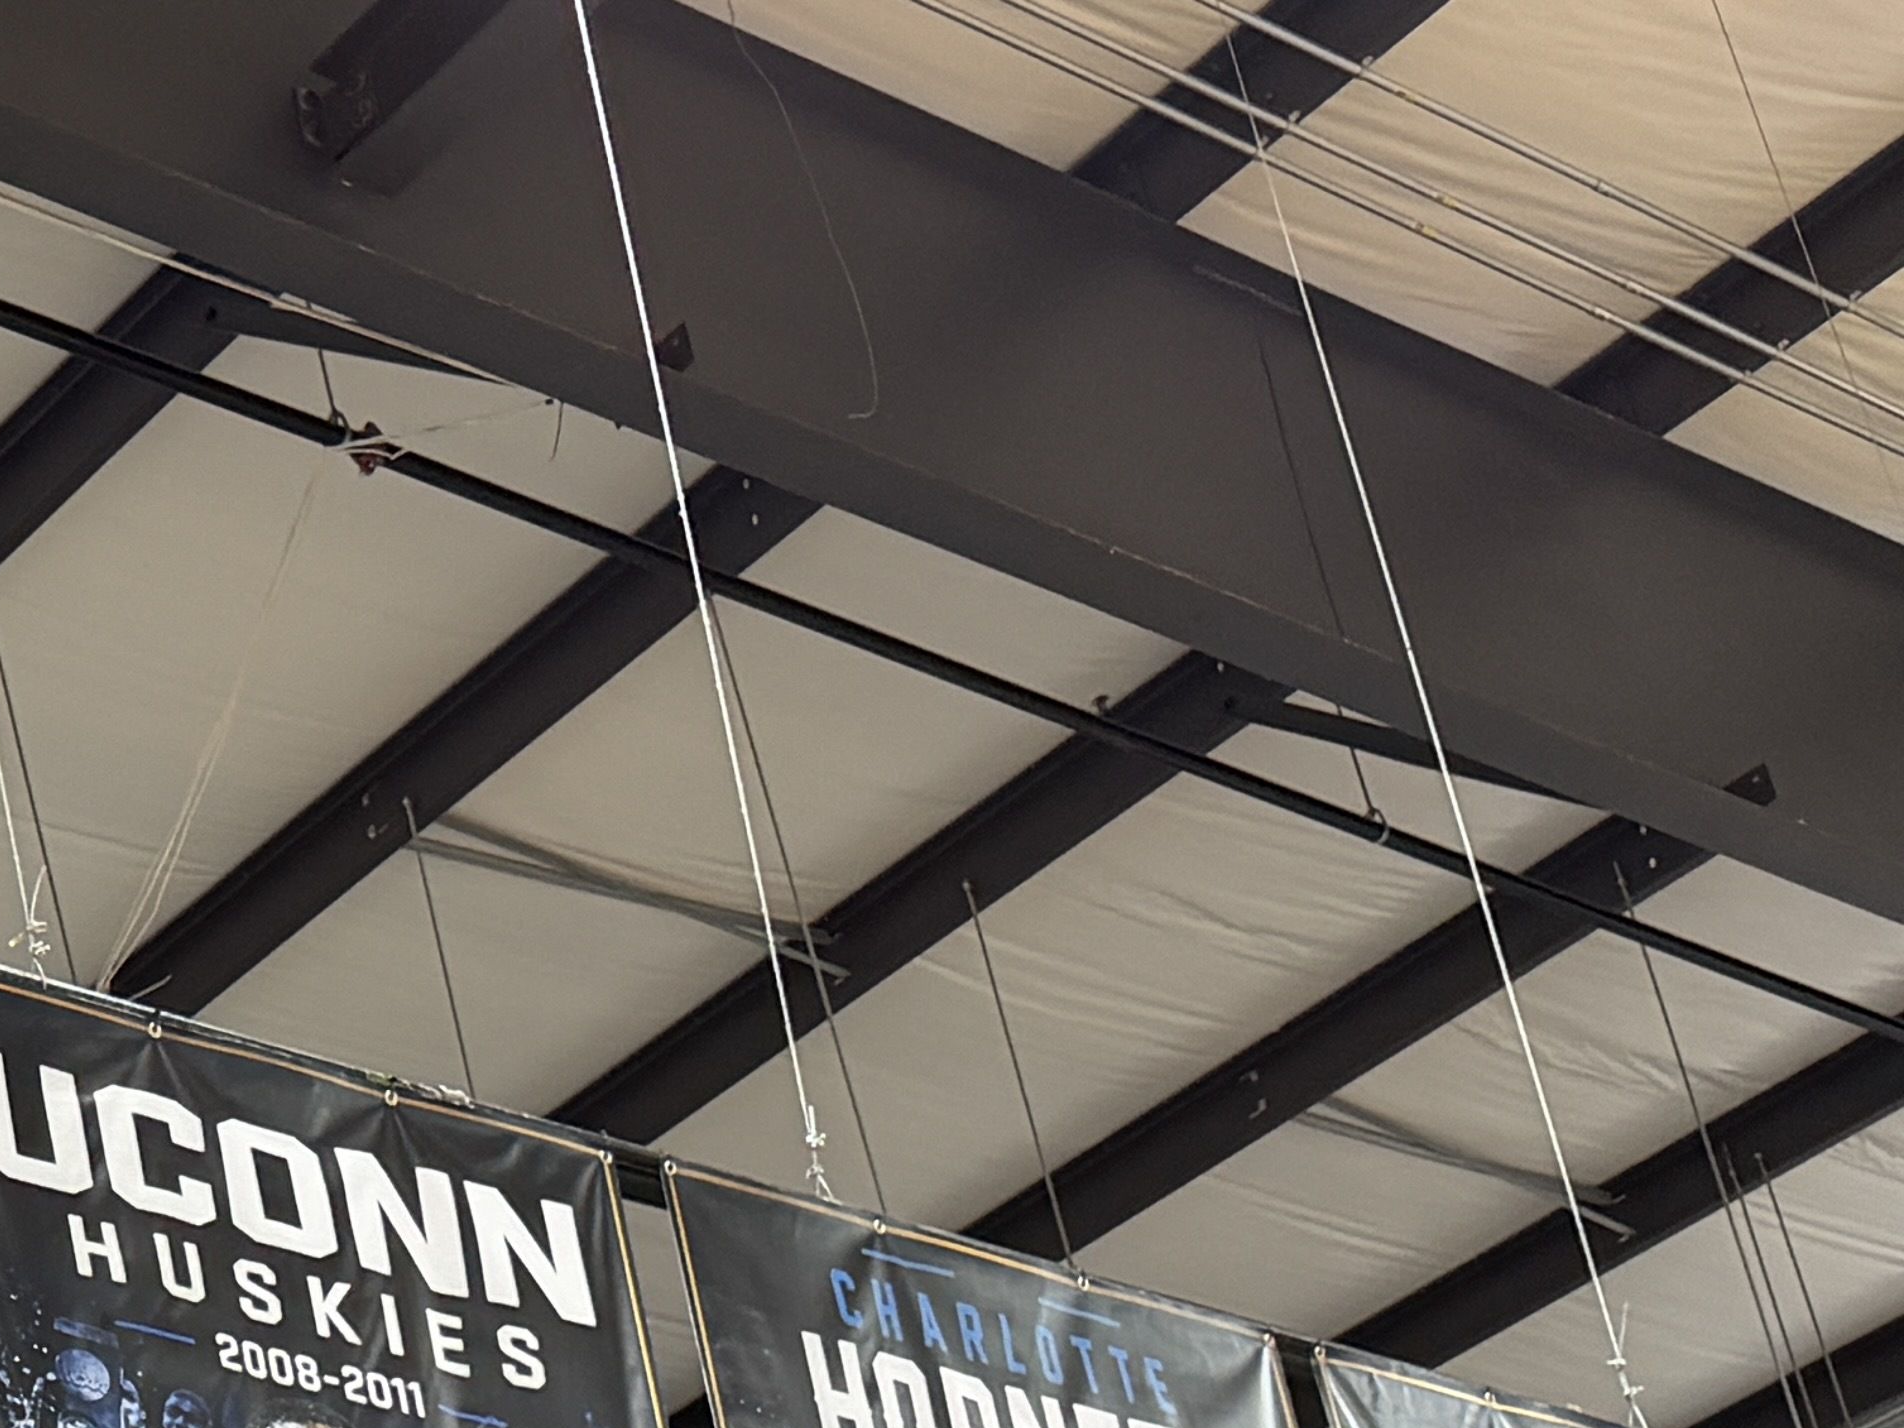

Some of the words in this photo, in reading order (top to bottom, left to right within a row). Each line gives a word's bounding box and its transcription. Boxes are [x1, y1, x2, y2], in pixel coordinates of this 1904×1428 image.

[67, 1213, 548, 1391] HUSKIES
[214, 1332, 429, 1420] 2008-2011
[830, 1268, 1177, 1418] CHARLOTTE
